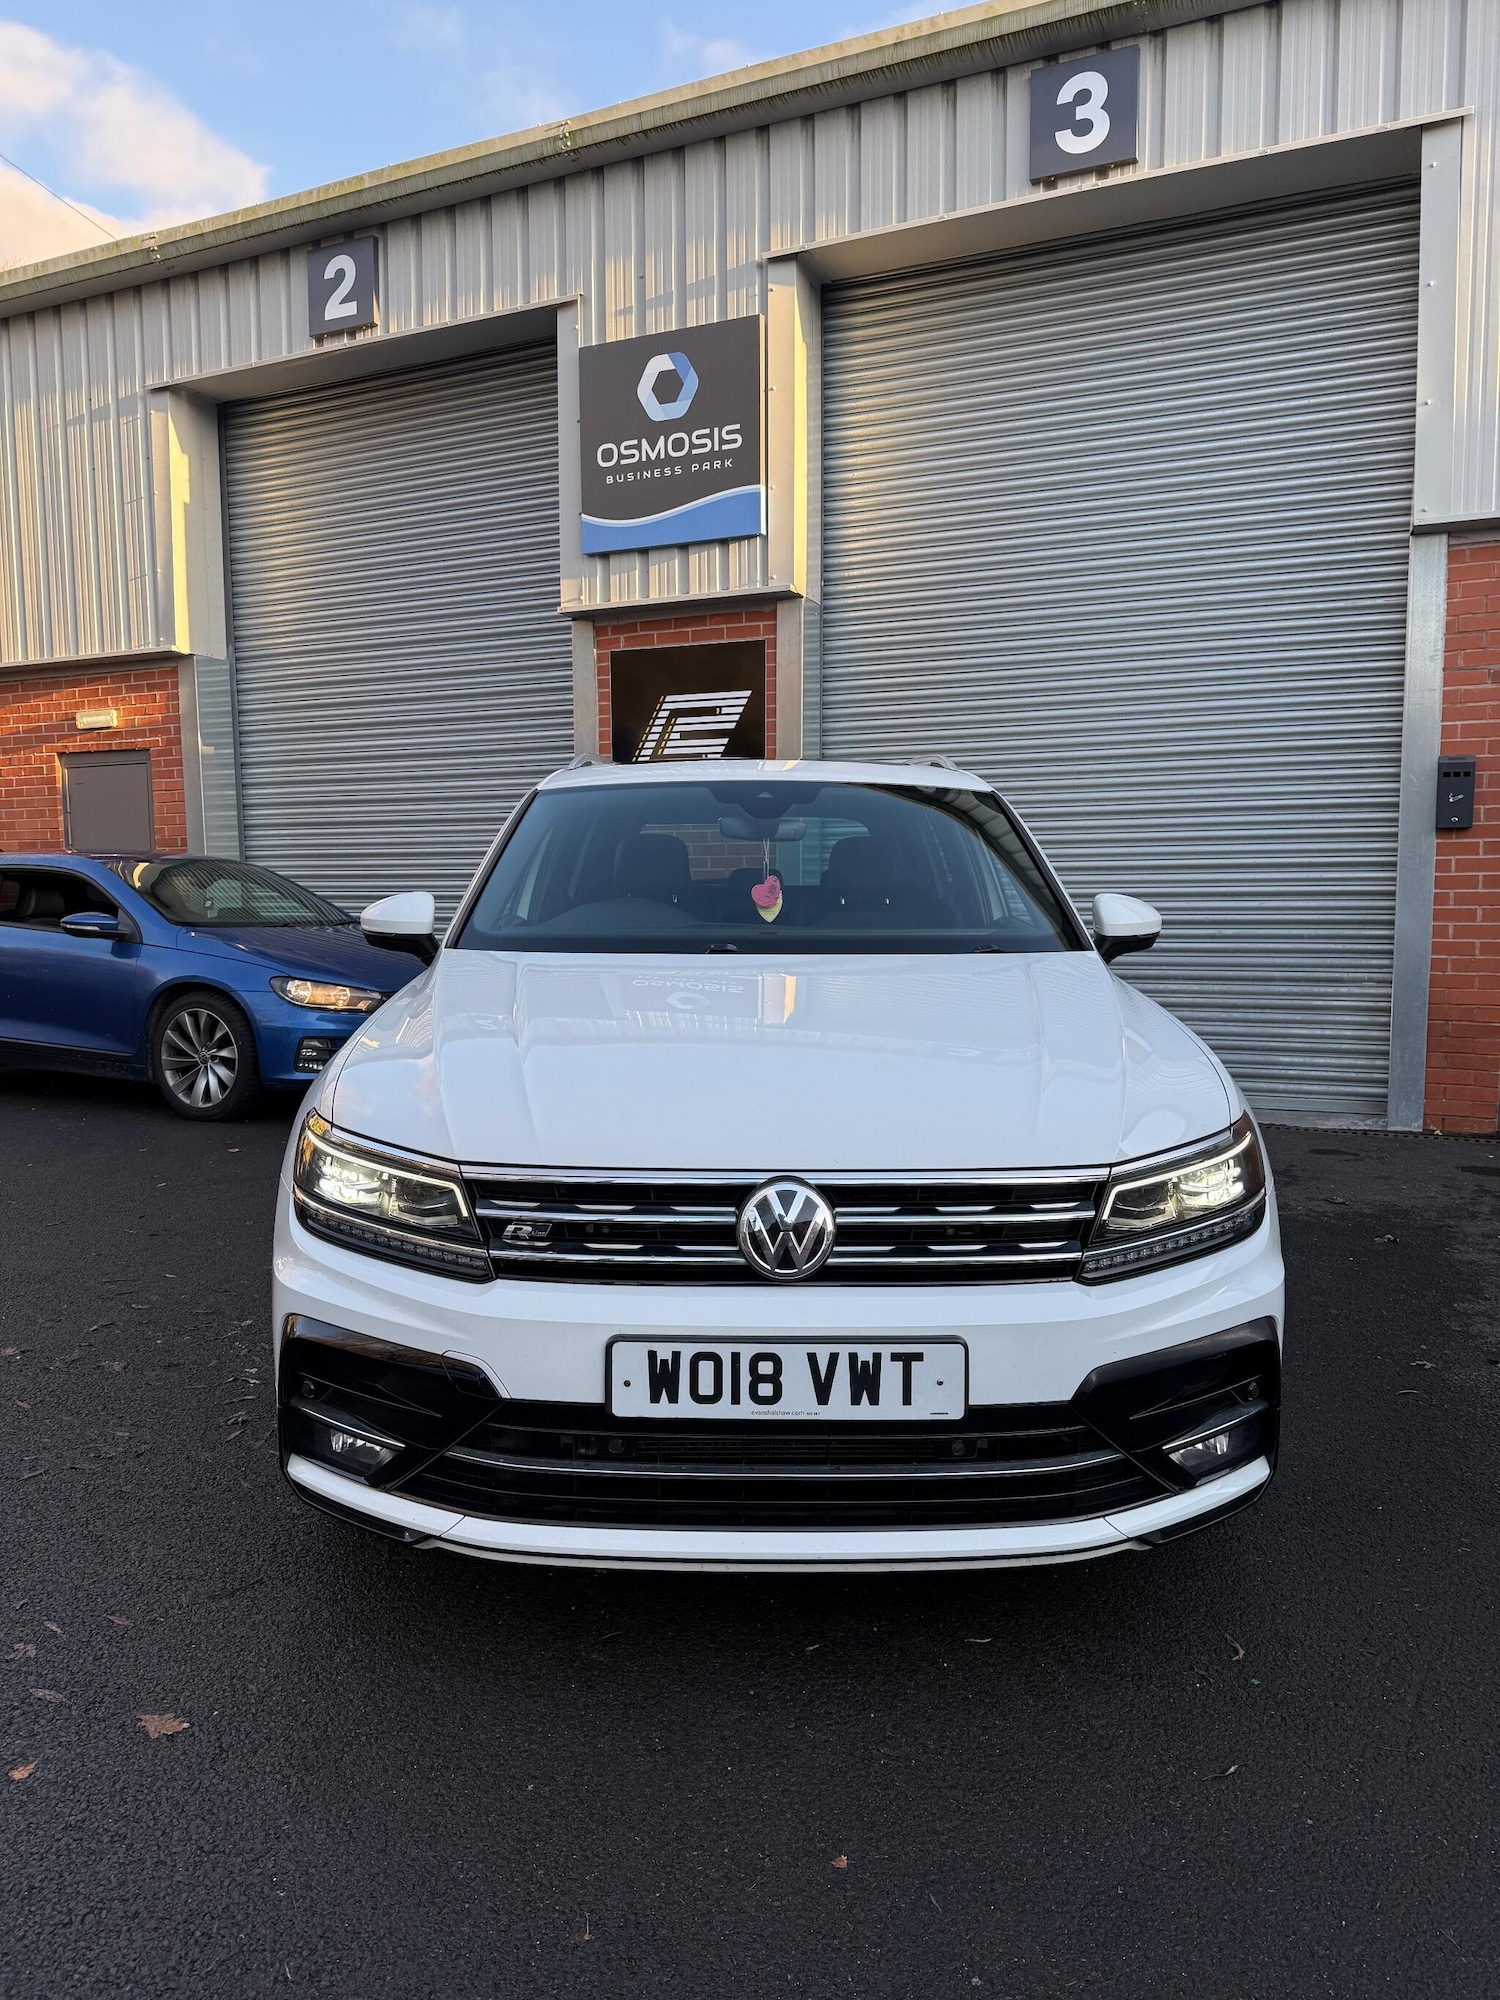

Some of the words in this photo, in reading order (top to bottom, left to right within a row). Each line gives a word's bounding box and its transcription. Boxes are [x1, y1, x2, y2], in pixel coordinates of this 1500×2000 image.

[1054, 71, 1110, 154] 3
[323, 254, 358, 321] 2
[596, 423, 743, 468] OSMOSIS
[606, 465, 683, 484] BUSINESS
[691, 458, 734, 473] PARK
[648, 1349, 783, 1405] WO18
[806, 1351, 925, 1406] VWT
